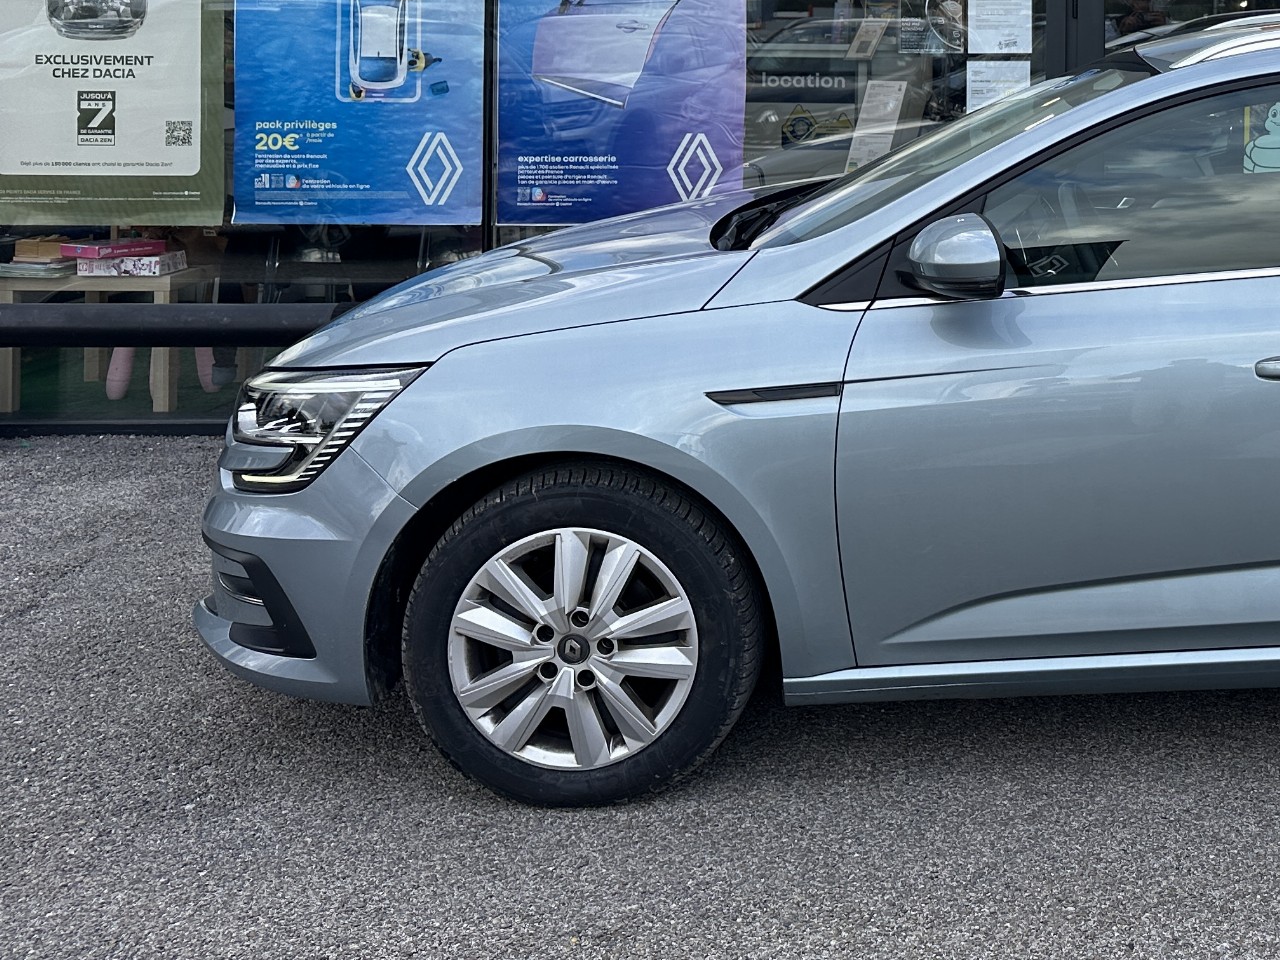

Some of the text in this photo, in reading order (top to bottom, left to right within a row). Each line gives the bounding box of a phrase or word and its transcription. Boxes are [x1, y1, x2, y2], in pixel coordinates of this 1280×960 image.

[35, 54, 154, 66] EXCLUSIVEMENT
[52, 68, 136, 79] CHEZ DACIA
[762, 72, 846, 88] location
[80, 101, 113, 127] 7
[256, 120, 337, 132] pack privilèges
[255, 133, 300, 150] 20€
[518, 154, 617, 163] expertise carrosserie
